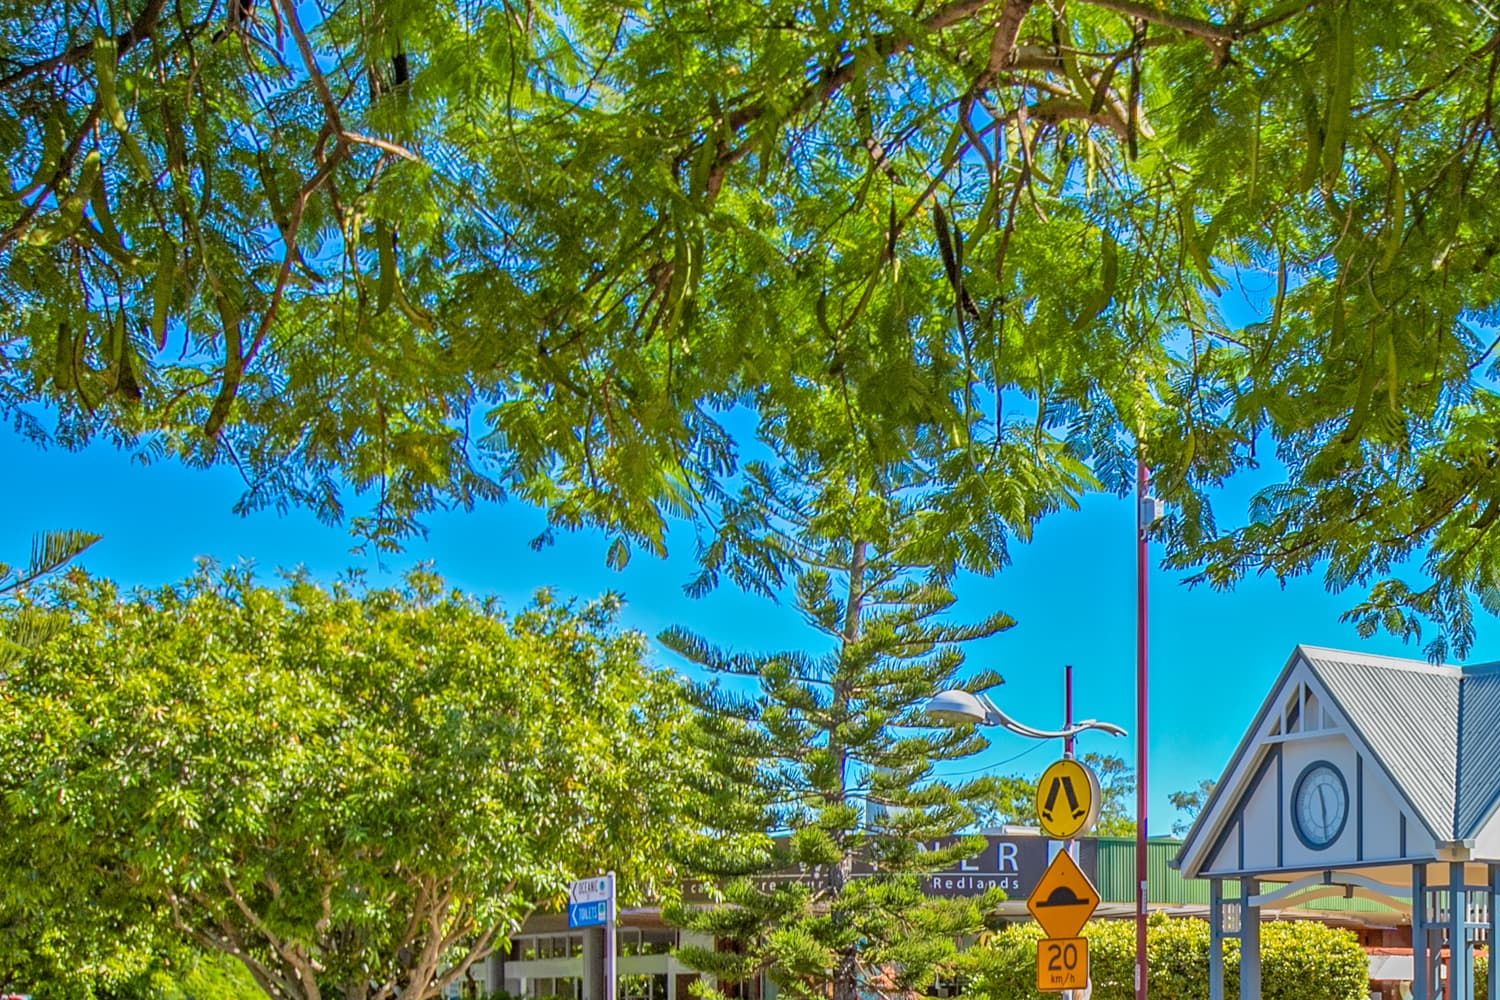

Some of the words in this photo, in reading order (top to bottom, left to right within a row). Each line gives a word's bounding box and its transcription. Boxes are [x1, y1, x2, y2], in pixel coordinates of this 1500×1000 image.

[933, 876, 1019, 889] Redlands
[578, 905, 598, 920] TOILETS
[1047, 943, 1078, 971] 20
[1050, 972, 1076, 985] km/h
